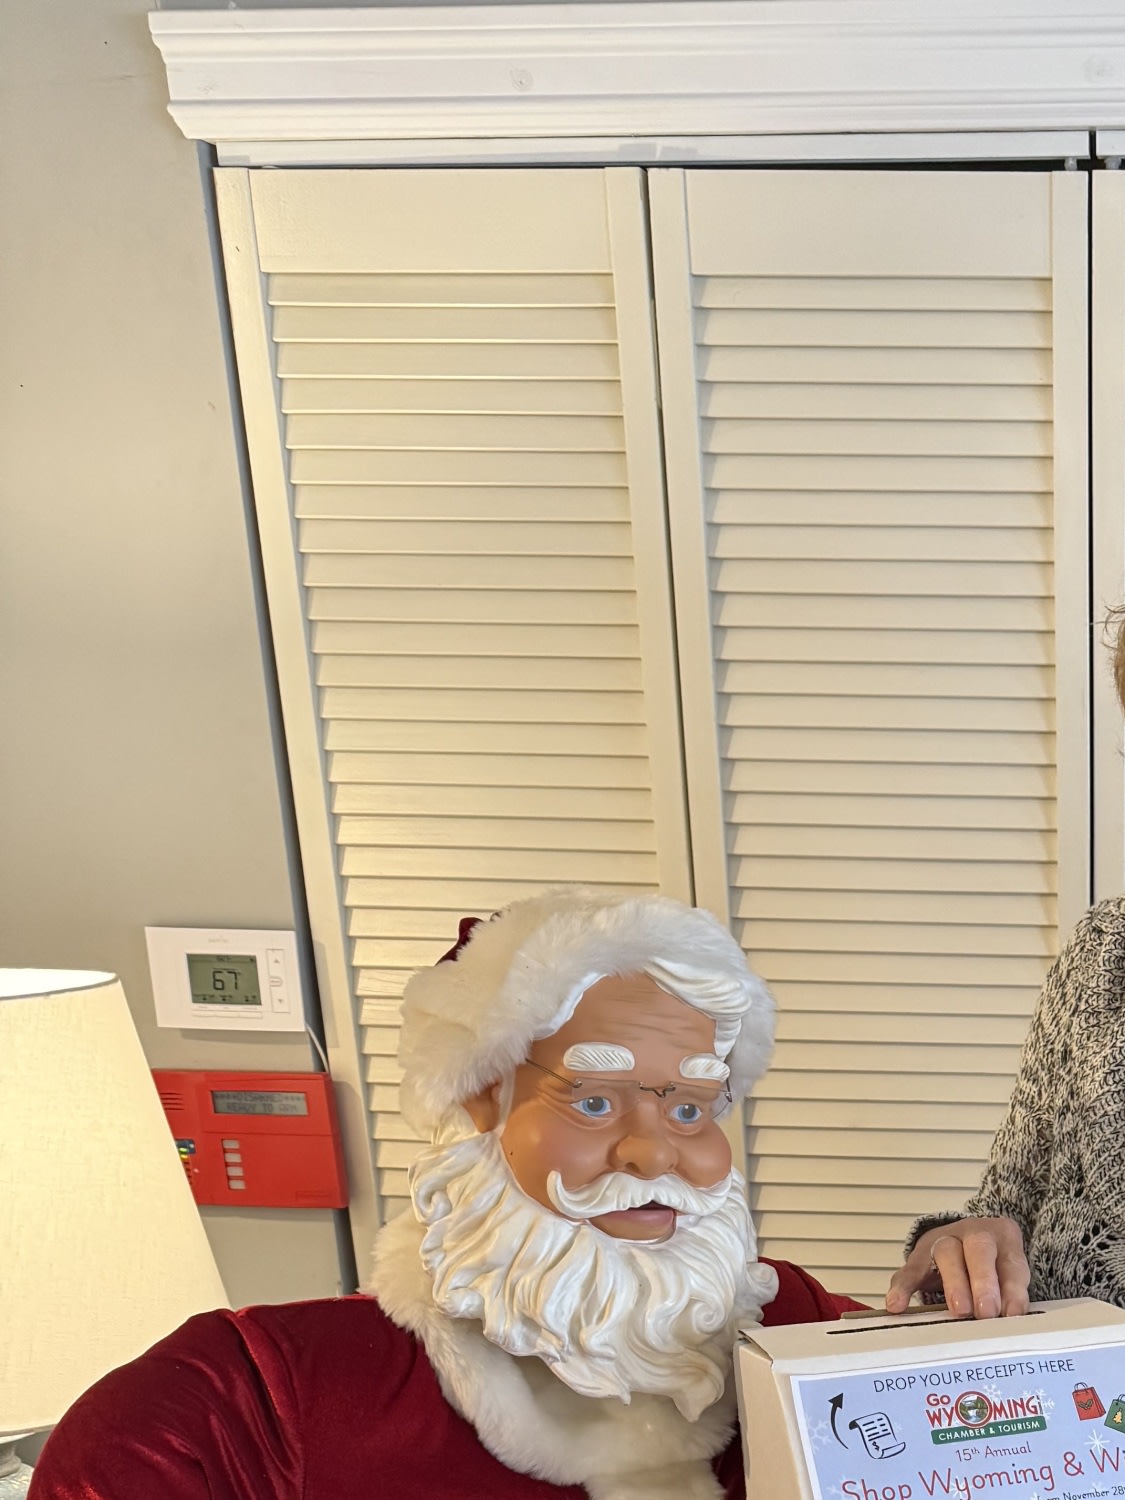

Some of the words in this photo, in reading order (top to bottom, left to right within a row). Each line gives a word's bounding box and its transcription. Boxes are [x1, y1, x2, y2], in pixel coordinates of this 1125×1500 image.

[212, 970, 238, 991] 67
[262, 1103, 274, 1113] TO
[873, 1376, 916, 1393] DROP
[919, 1370, 963, 1387] YOUR
[966, 1361, 1035, 1381] RECEIPTS
[1038, 1359, 1075, 1373] HERE
[926, 1393, 951, 1406] Go
[938, 1427, 985, 1441] CHAMBER
[999, 1421, 1040, 1433] TOURISM
[955, 1447, 980, 1462] 15th
[984, 1441, 1032, 1458] Annual
[1063, 1451, 1085, 1476] &
